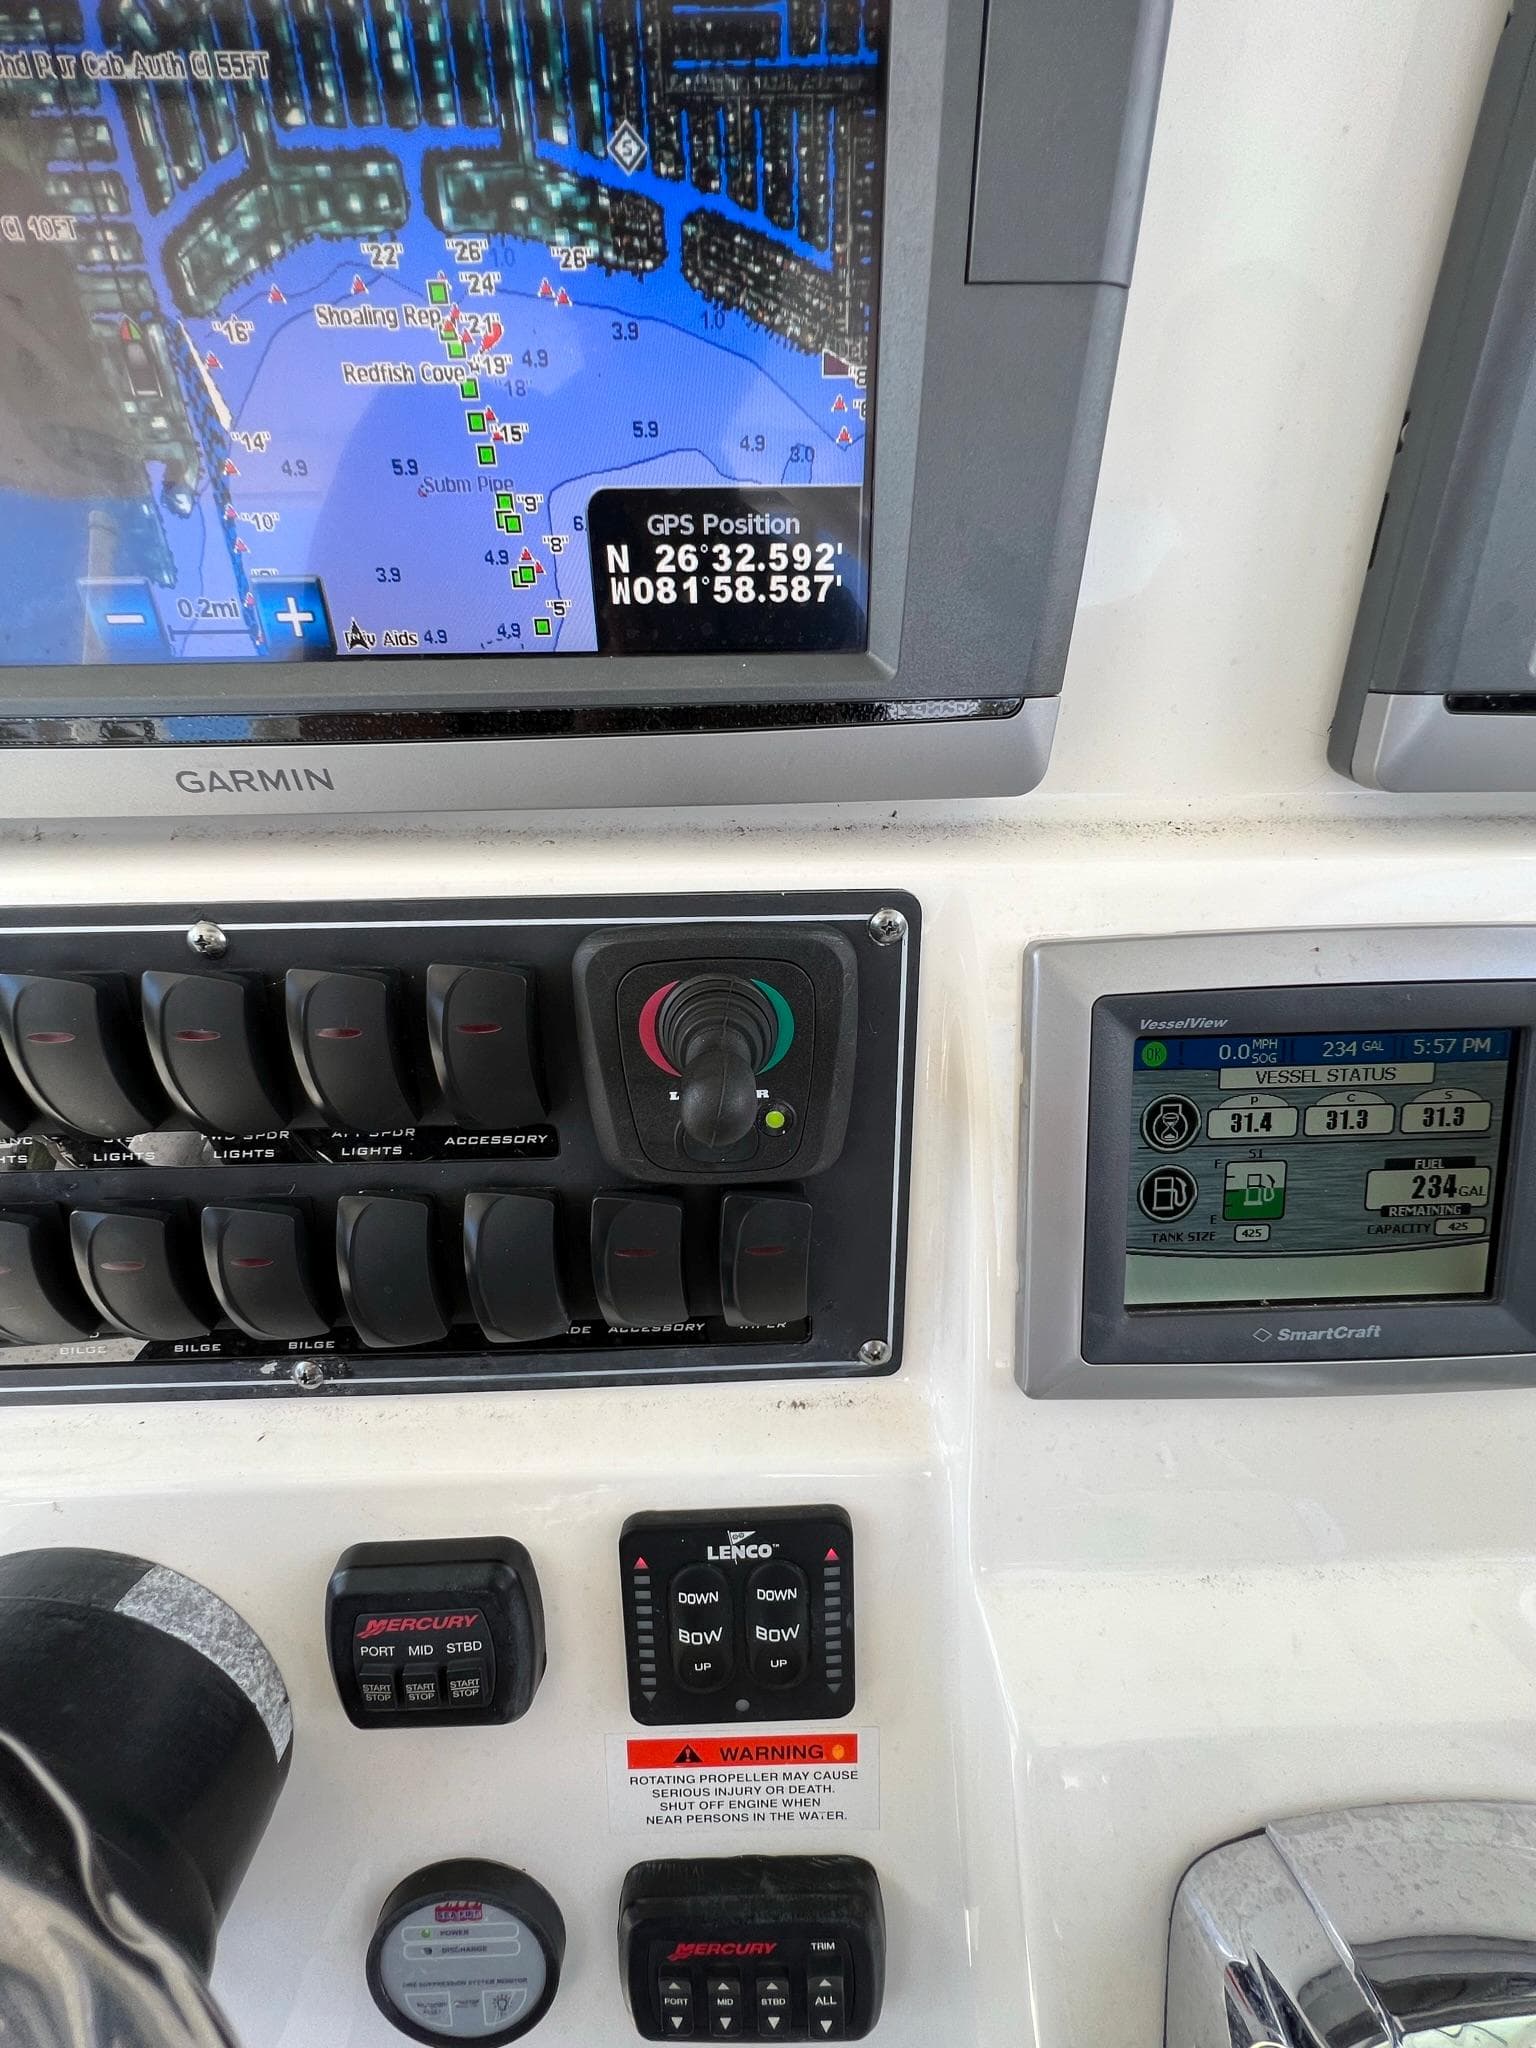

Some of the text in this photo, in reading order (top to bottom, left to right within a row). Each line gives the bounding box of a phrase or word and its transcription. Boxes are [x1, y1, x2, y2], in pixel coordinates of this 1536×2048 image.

[134, 51, 187, 79] Auth
[214, 51, 269, 79] 55FT
[315, 305, 399, 329] Shoaling
[611, 322, 639, 341] 3.9
[521, 350, 549, 368] 4.9
[343, 362, 465, 384] Redfish Cove
[632, 421, 659, 439] 5.9
[739, 435, 766, 452] 4.9
[281, 459, 308, 477] 4.9
[391, 458, 419, 476] 5.9
[423, 476, 514, 494] Subm Pipe
[647, 512, 801, 536] GPS Position
[484, 549, 510, 565] 4.9
[606, 544, 630, 574] N
[375, 567, 401, 583] 3.9
[177, 597, 239, 619] 0.2mi
[383, 631, 418, 647] Aids
[423, 629, 448, 645] 4.9
[496, 623, 521, 639] 4.9
[175, 767, 335, 794] GARMIN
[1140, 1017, 1228, 1032] VesselView
[1218, 1038, 1278, 1064] 0.0 MPH SOG
[1322, 1040, 1385, 1058] 234 GAL
[1412, 1037, 1492, 1056] 5:57 PM
[1256, 1066, 1397, 1085] VESSEL STATUS
[756, 1089, 770, 1099] R
[1250, 1096, 1259, 1105] P
[1230, 1111, 1273, 1133] 31.4
[1326, 1109, 1369, 1131] 31.3
[1422, 1106, 1465, 1128] 31.3
[444, 1134, 549, 1146] ACCESSORY
[93, 1151, 156, 1163] LIGHTS
[213, 1149, 275, 1159] LIGHTS
[341, 1146, 403, 1156] LIGHTS
[1414, 1158, 1446, 1170] FUEL
[1411, 1174, 1487, 1200] 234 GAL
[1388, 1204, 1463, 1217] REMAINING
[1241, 1228, 1263, 1239] 425
[1367, 1221, 1469, 1236] CAPACITY 425
[1151, 1230, 1217, 1244] TANK SIZE
[1276, 1324, 1382, 1342] SmartCraft
[59, 1345, 108, 1356] BILGE
[174, 1343, 222, 1353] BILGE
[288, 1340, 336, 1350] BILGE
[706, 1543, 773, 1561] LENCO
[678, 1591, 719, 1605] DOWN
[756, 1587, 798, 1601] DOWN
[356, 1614, 481, 1639] MERCURY
[755, 1624, 800, 1642] BOW
[678, 1627, 723, 1645] BOW
[360, 1640, 483, 1657] PORT MID STBD
[694, 1661, 712, 1672] UP
[770, 1659, 788, 1668] UP
[362, 1683, 392, 1693] START
[405, 1682, 435, 1692] START
[450, 1678, 480, 1689] START
[365, 1692, 392, 1702] STOP
[408, 1692, 435, 1701] STOP
[452, 1688, 480, 1698] STOP
[720, 1744, 824, 1761] WARNING
[630, 1770, 859, 1786] ROTATING PROPELLER MAY CAUSE
[652, 1783, 835, 1798] SERIOUS INJURY OR DEATH.
[659, 1797, 821, 1812] SHUT OFF ENGINE WHEN
[646, 1810, 848, 1825] NEAR PERSONS IN THE WATER.
[440, 1929, 470, 1937] POWER
[441, 1945, 488, 1954] DISCHARGE
[667, 1941, 778, 1962] MERCURY
[811, 1941, 836, 1951] TRIM
[664, 1997, 689, 2006] PORT
[717, 1997, 734, 2006] MID
[761, 1997, 786, 2006] STBD
[815, 1995, 837, 2006] ALL
